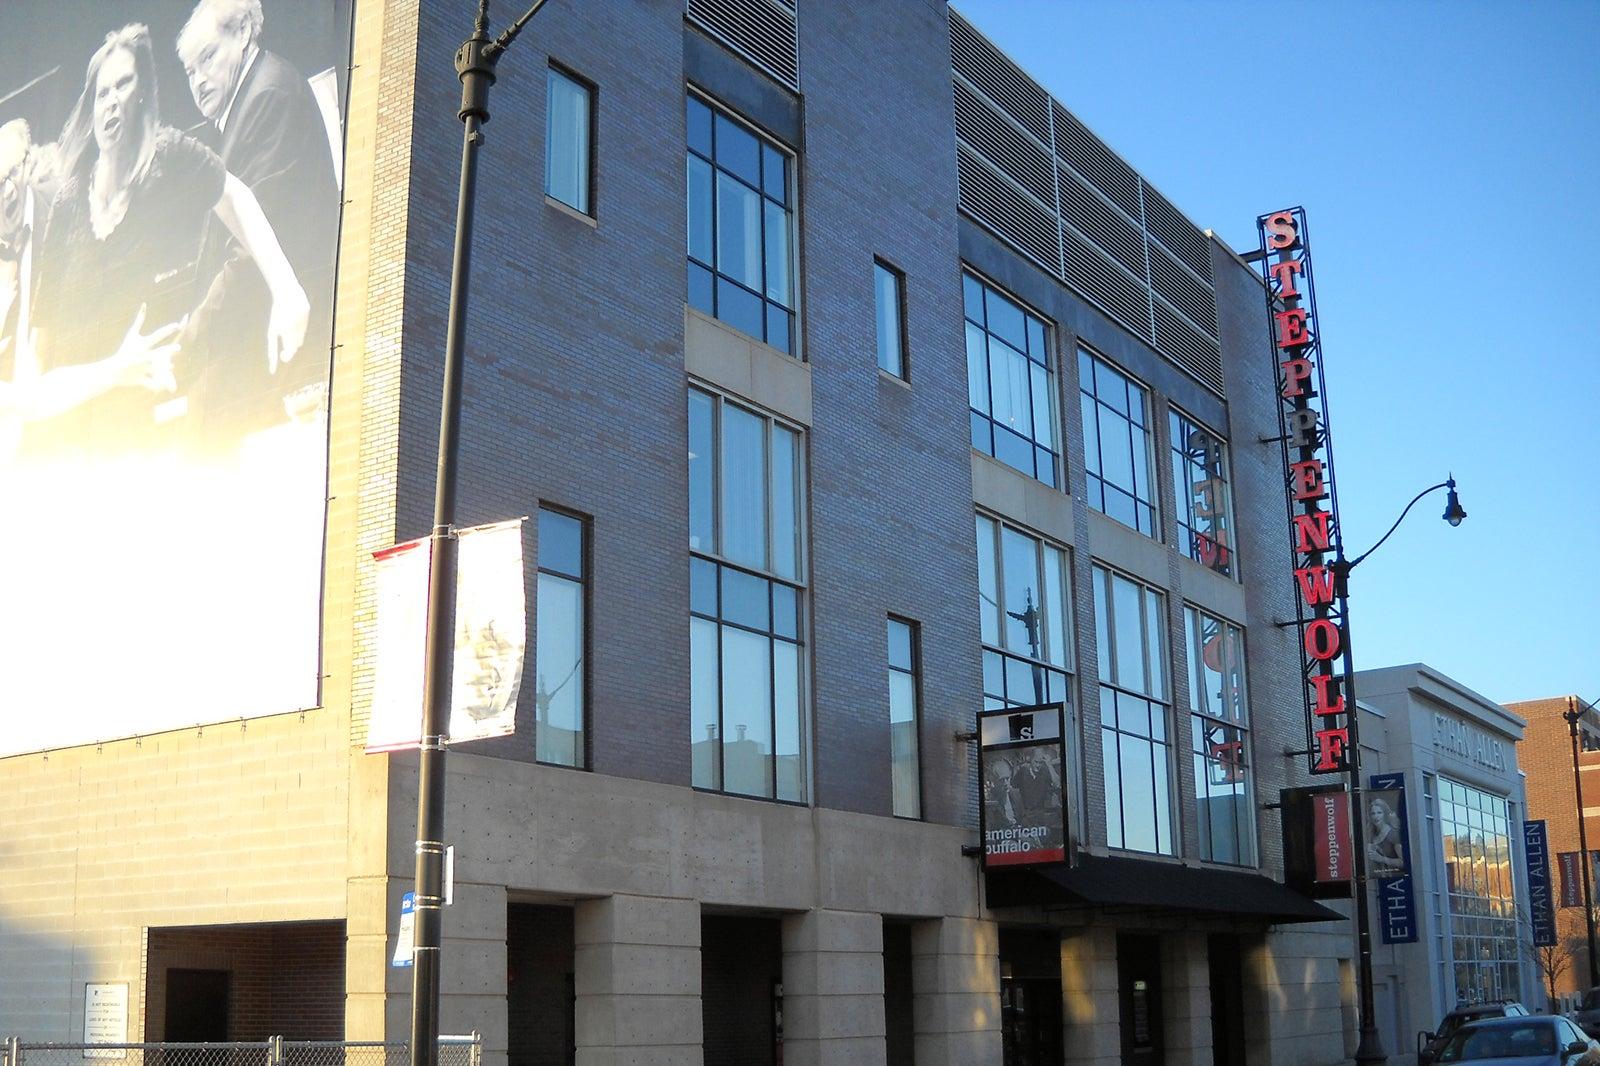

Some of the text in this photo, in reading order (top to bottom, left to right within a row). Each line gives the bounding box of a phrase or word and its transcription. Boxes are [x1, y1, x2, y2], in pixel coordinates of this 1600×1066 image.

[1266, 211, 1349, 770] STEPPENWOLF
[1472, 733, 1507, 772] ALLEN
[985, 825, 1047, 840] american
[1324, 797, 1339, 878] steppenwolf
[1526, 823, 1550, 943] ETHAN ALLEN
